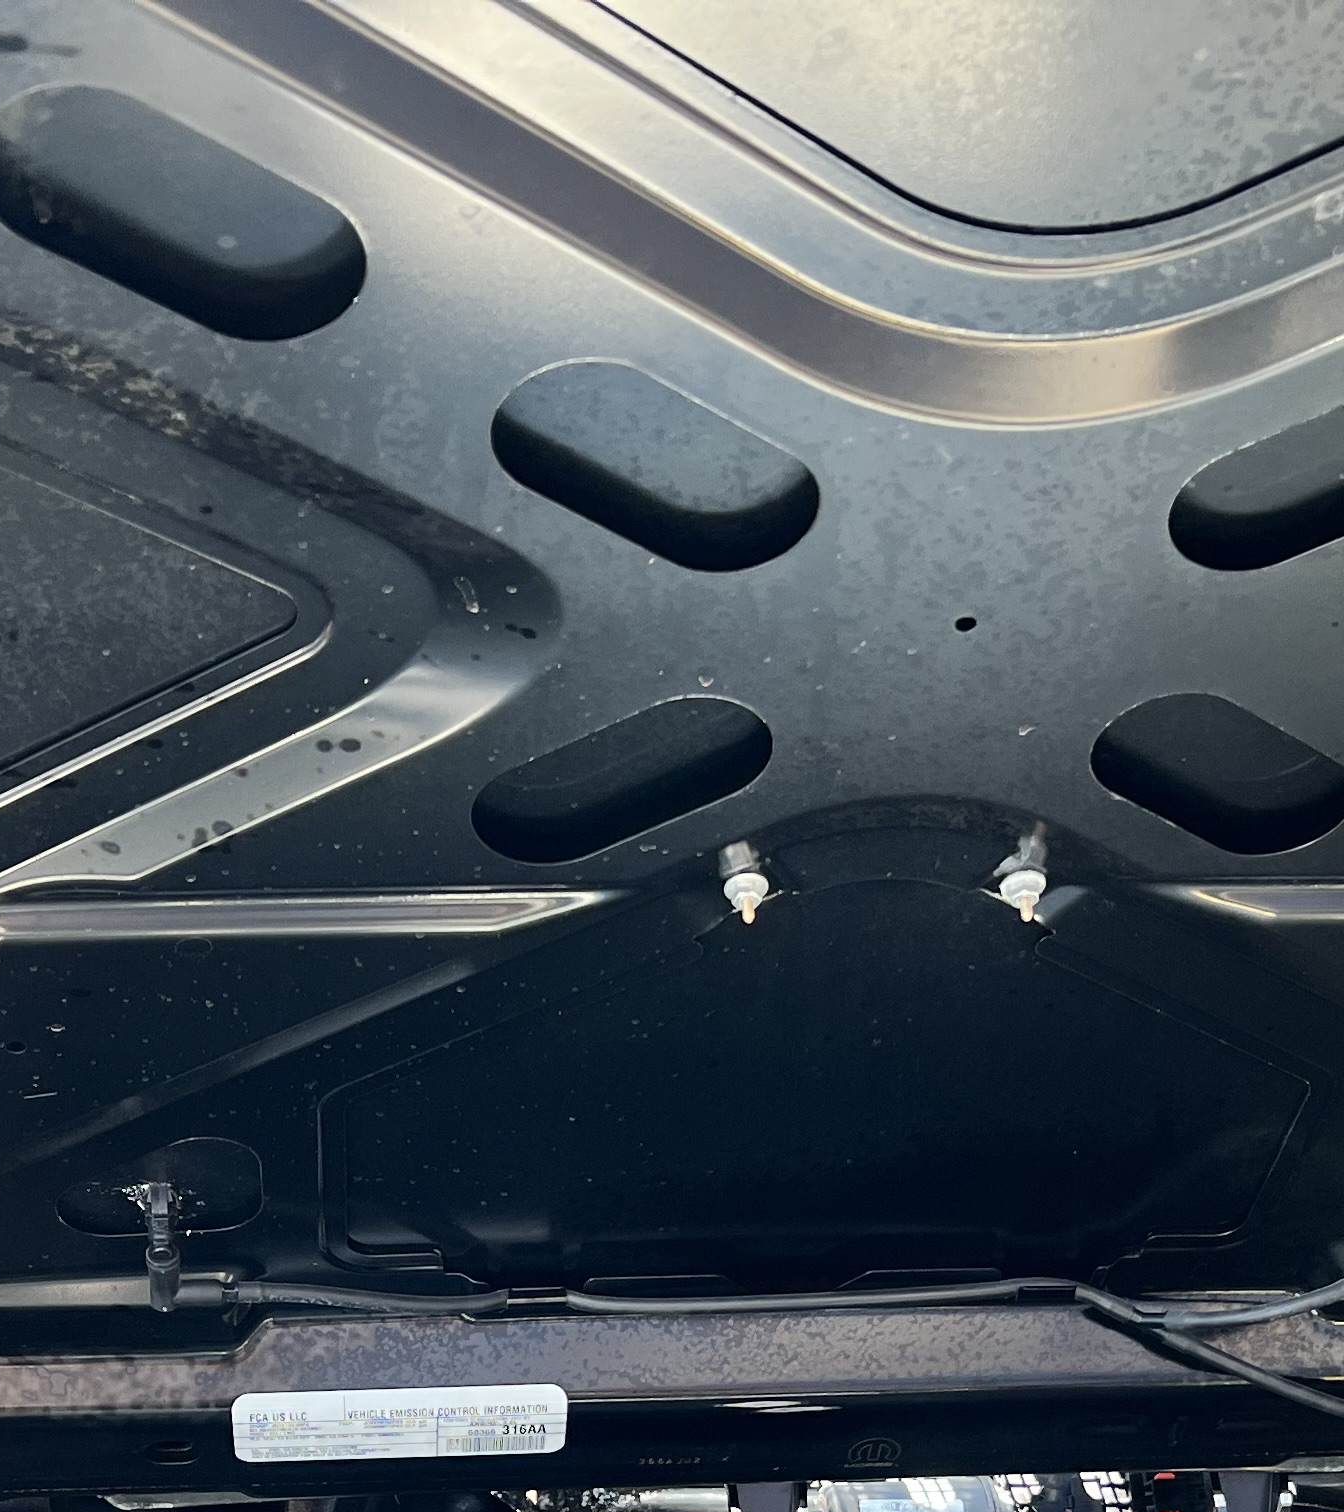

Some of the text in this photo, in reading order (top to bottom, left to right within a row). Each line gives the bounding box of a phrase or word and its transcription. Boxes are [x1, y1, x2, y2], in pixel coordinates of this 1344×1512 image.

[249, 1411, 308, 1423] FCA US LLC
[347, 1404, 549, 1420] VEHICLE EMISSION CONTROL INFORMATION
[502, 1423, 547, 1435] 316AA
